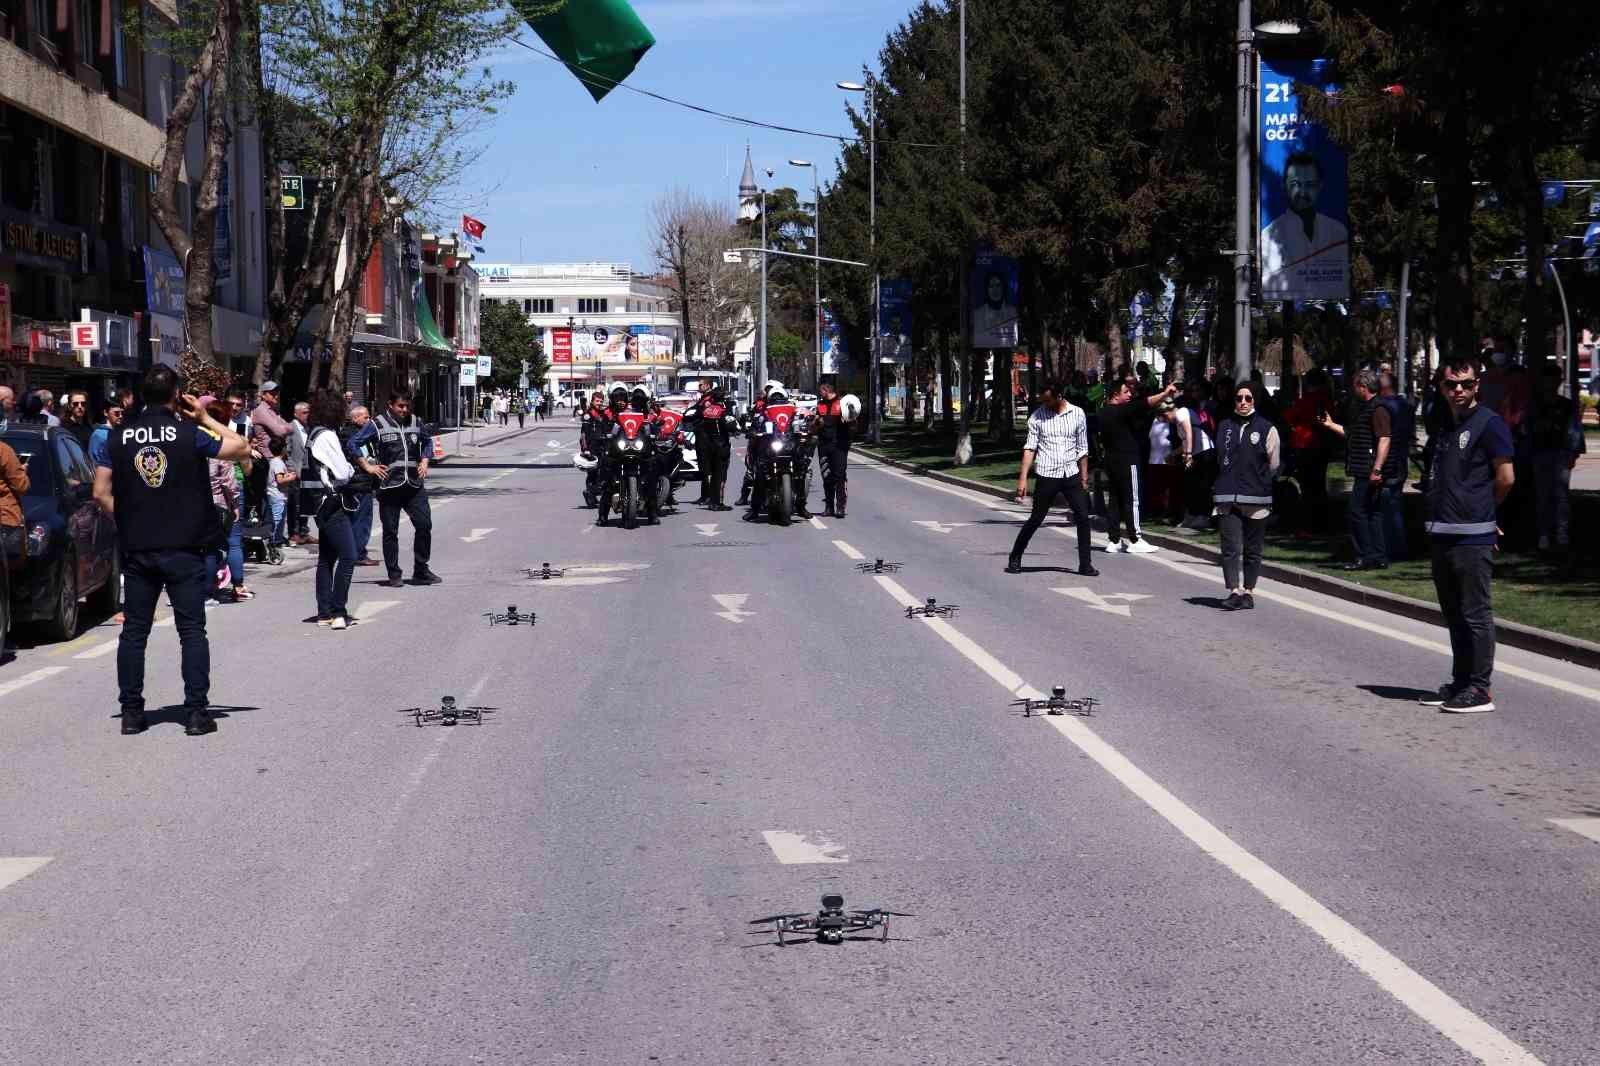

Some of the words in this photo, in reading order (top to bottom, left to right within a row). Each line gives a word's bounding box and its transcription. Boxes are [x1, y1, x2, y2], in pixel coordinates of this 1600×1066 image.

[1264, 82, 1289, 103] 21
[1266, 113, 1298, 126] MAR
[77, 327, 93, 346] E
